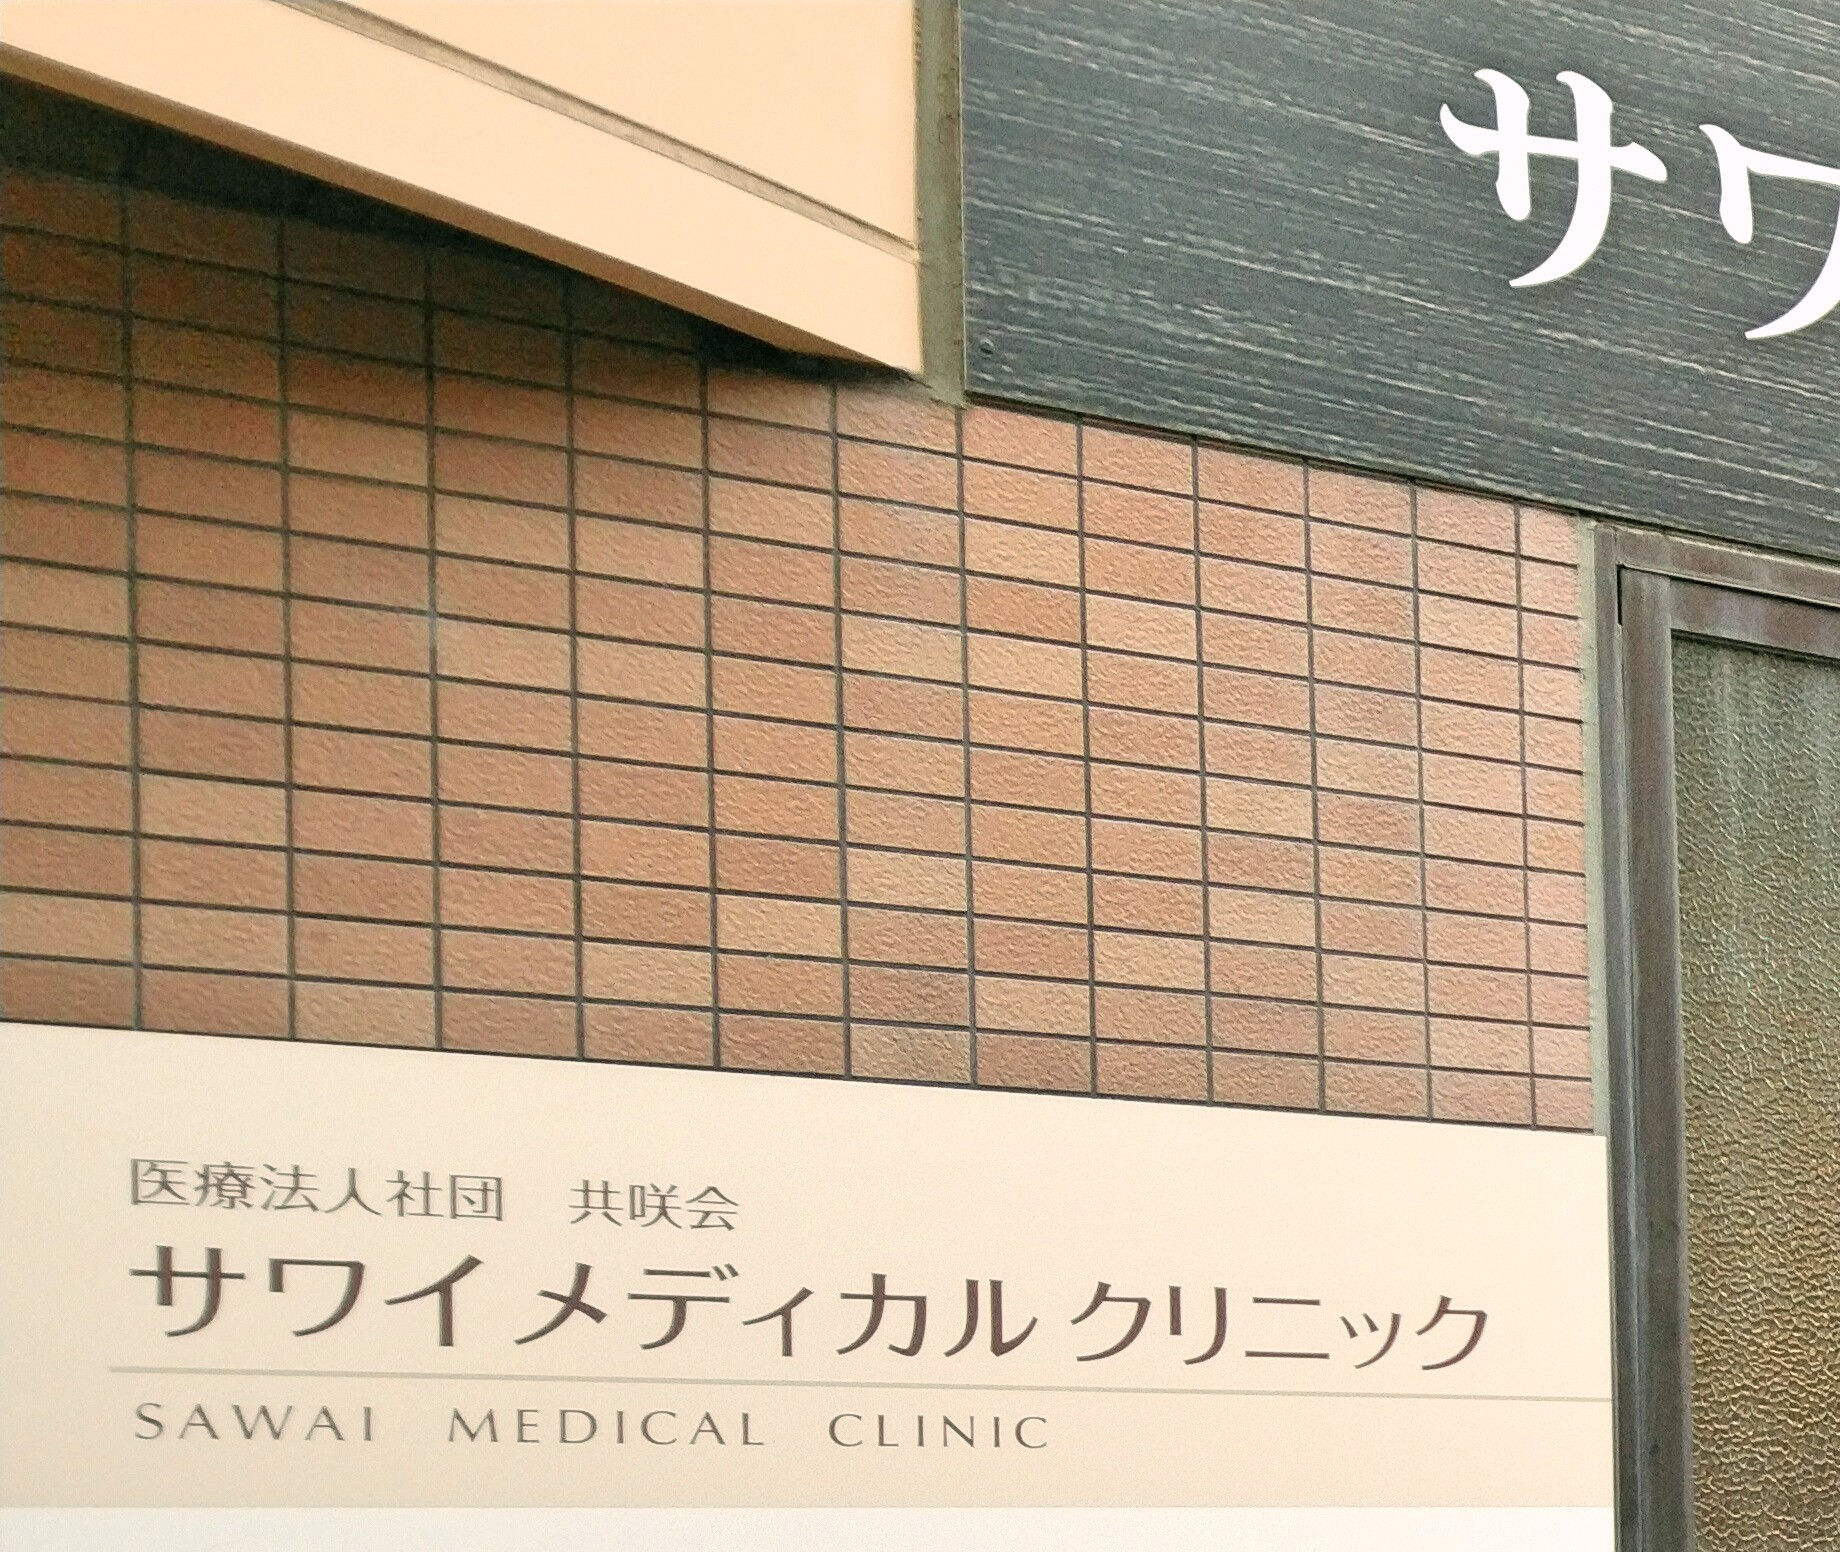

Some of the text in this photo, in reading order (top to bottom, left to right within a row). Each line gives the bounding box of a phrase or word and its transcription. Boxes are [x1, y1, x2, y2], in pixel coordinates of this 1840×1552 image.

[128, 1157, 741, 1232] 医療法人社団 共咲会
[133, 1401, 1050, 1450] SAWAI MEDICAL CLINIC
